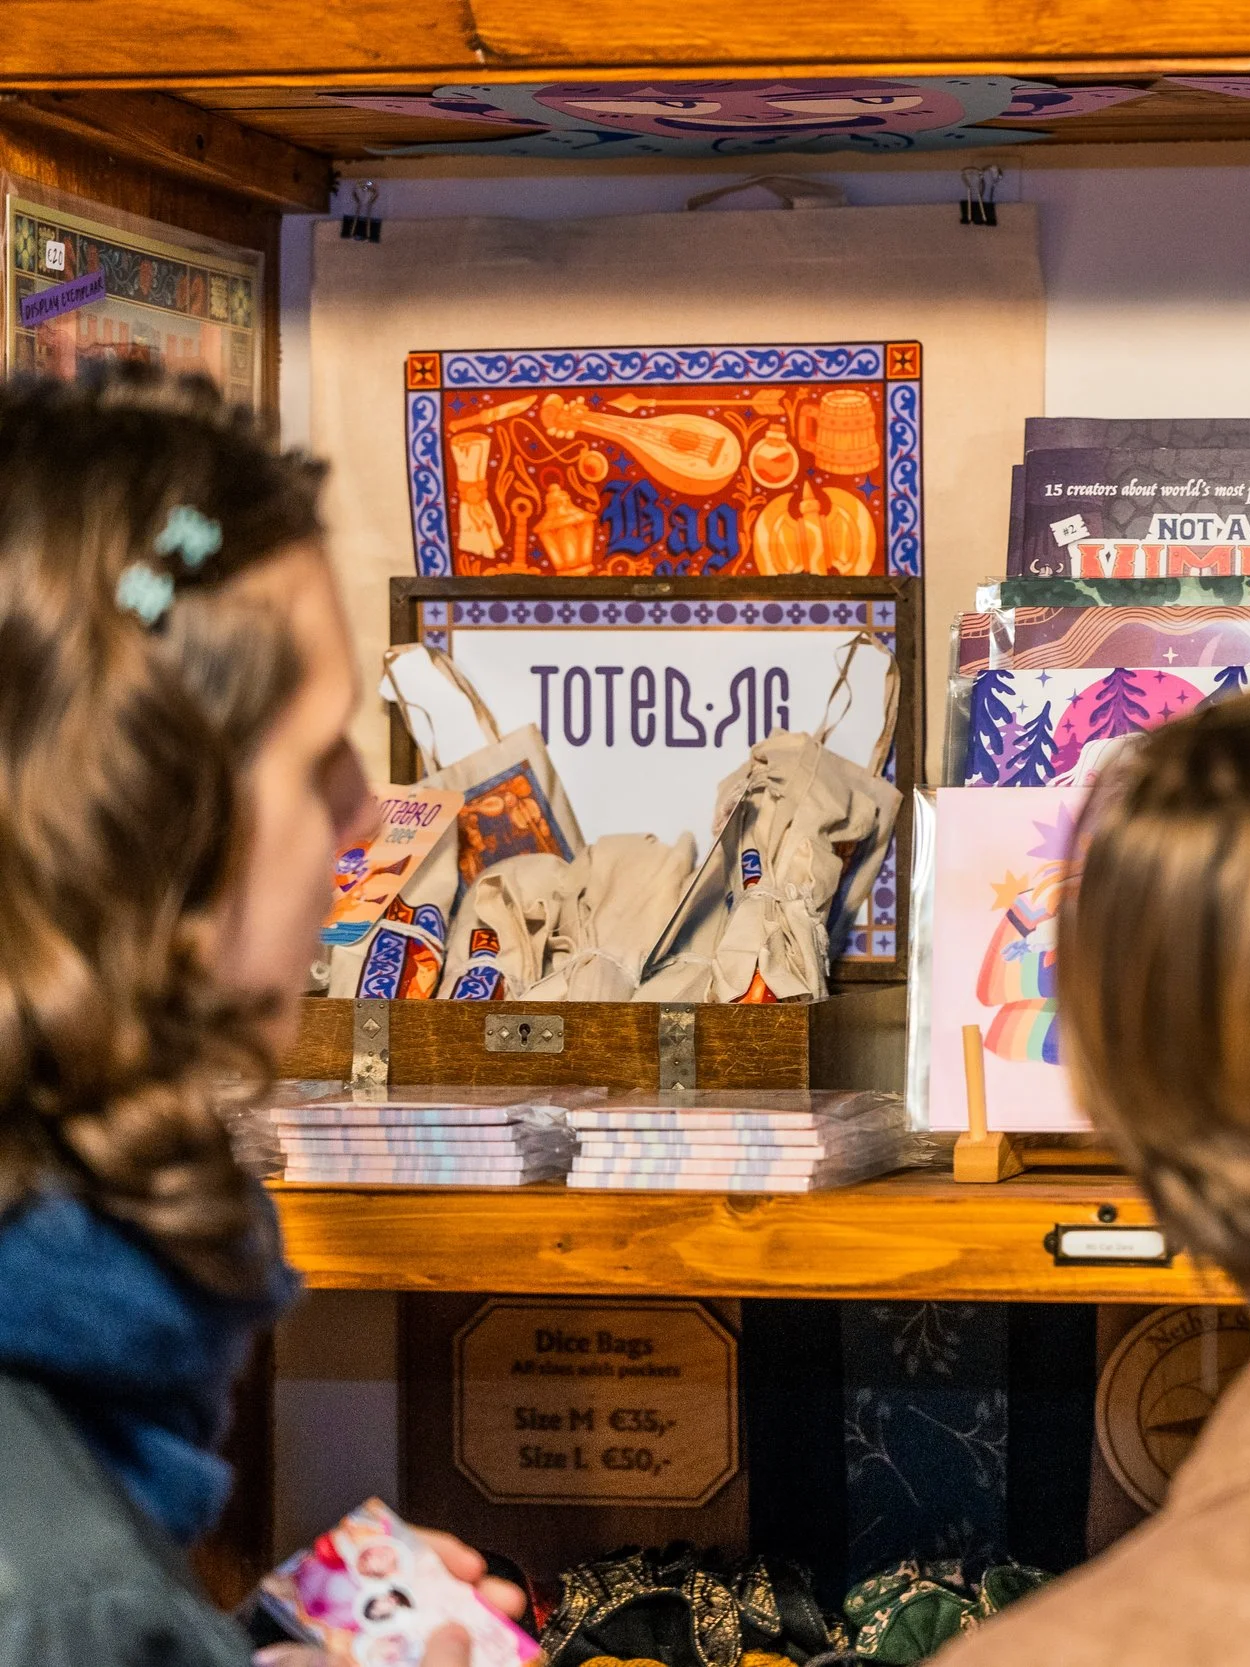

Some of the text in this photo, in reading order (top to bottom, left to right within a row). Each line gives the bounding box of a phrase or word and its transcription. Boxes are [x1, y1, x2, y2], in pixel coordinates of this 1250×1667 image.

[48, 248, 63, 266] €20
[26, 296, 60, 320] DISPLAY
[1045, 484, 1062, 497] 15
[1066, 483, 1118, 497] creators
[1122, 478, 1156, 497] about
[1160, 478, 1211, 497] world's
[1214, 483, 1244, 497] most
[602, 479, 739, 576] Bag
[1062, 524, 1078, 536] #2
[1158, 518, 1246, 540] NOT A
[535, 1328, 653, 1360] Dice Bags
[514, 1407, 562, 1431] Size
[568, 1407, 594, 1431] M
[520, 1446, 567, 1469] Size
[574, 1446, 588, 1469] L
